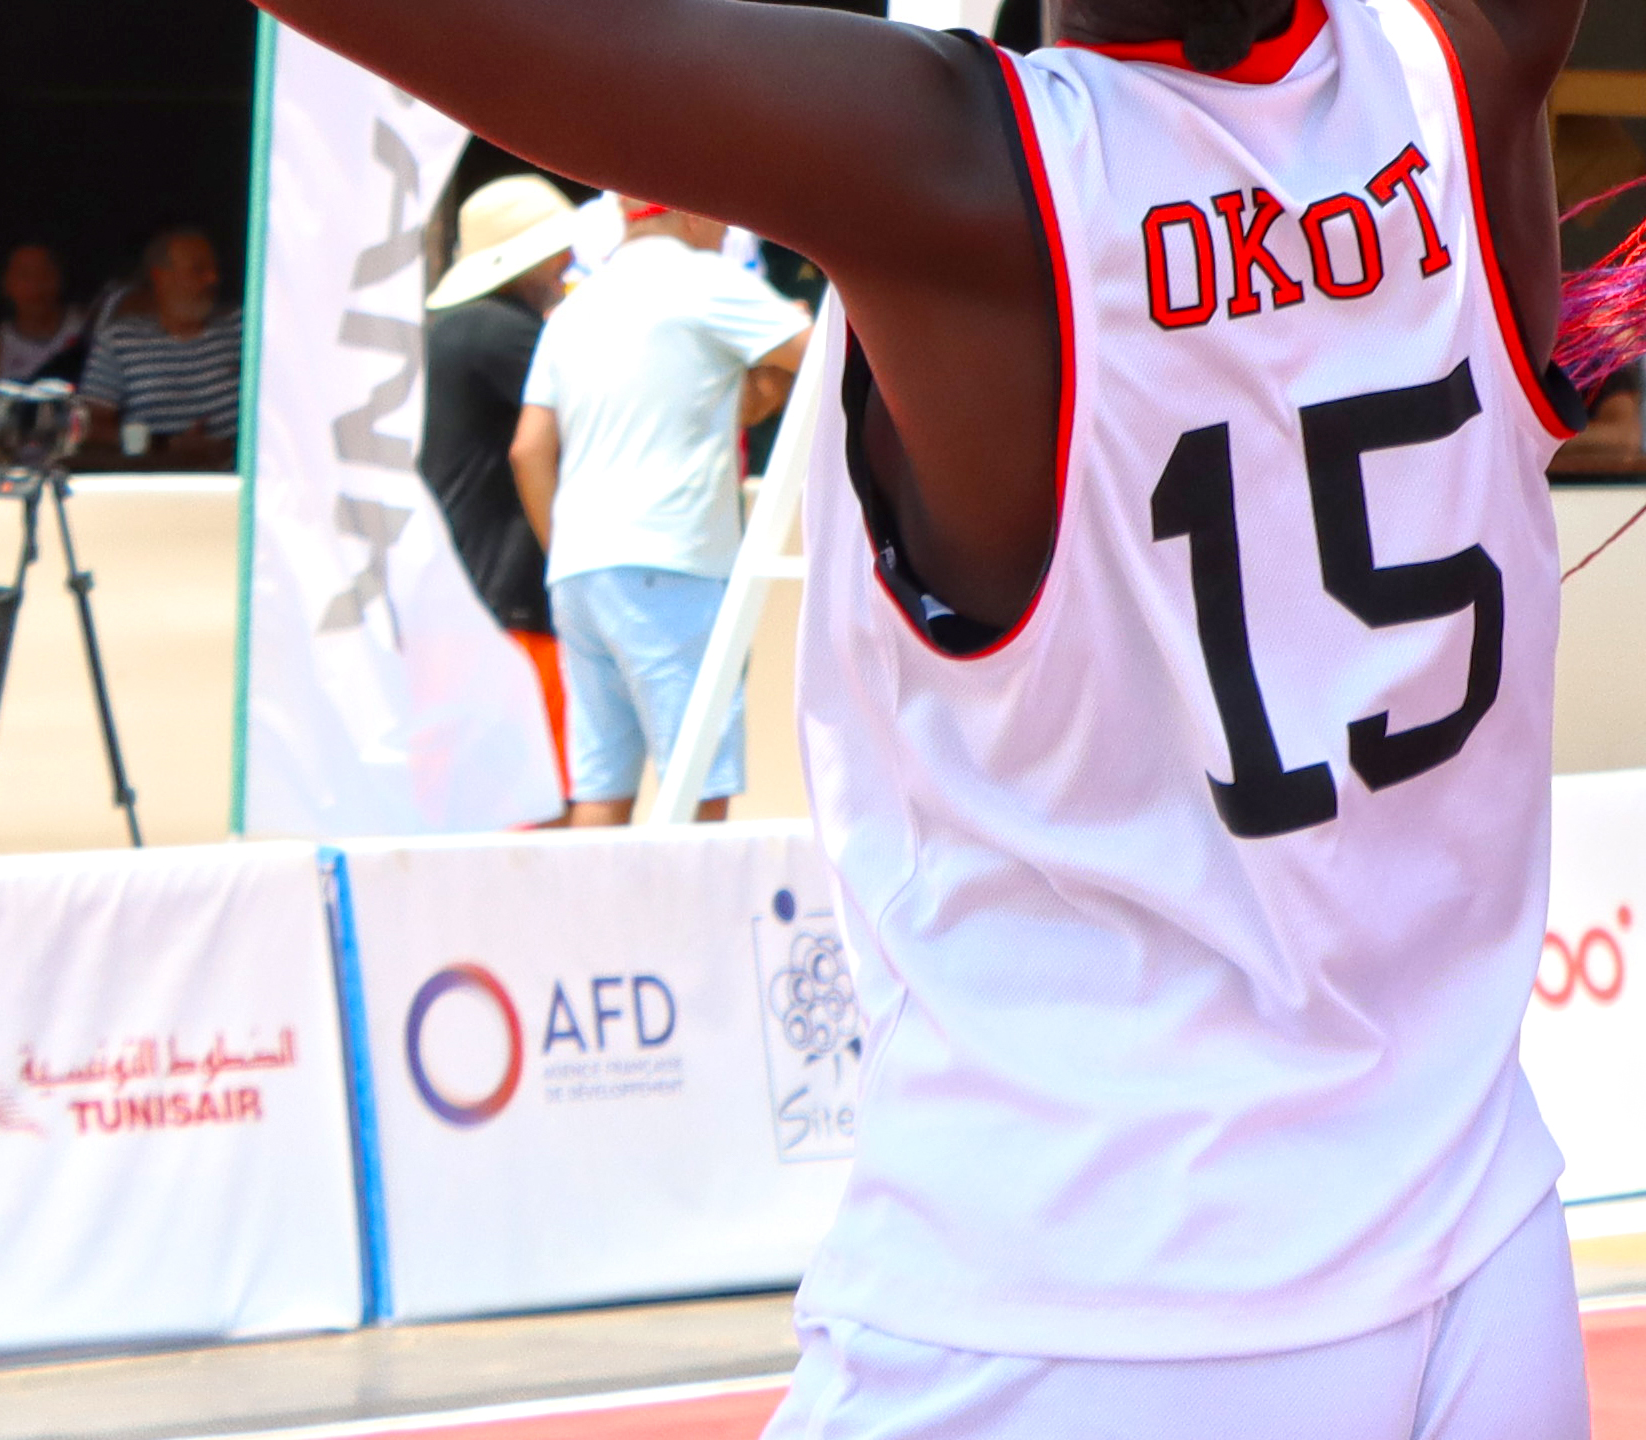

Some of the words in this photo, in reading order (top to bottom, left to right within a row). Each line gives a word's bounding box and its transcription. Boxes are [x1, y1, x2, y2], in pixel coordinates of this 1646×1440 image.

[1142, 142, 1452, 331] OKOT
[316, 84, 425, 654] ANK
[1150, 357, 1505, 840] 15
[543, 975, 677, 1054] AFD
[69, 1087, 263, 1137] TUNISAIR
